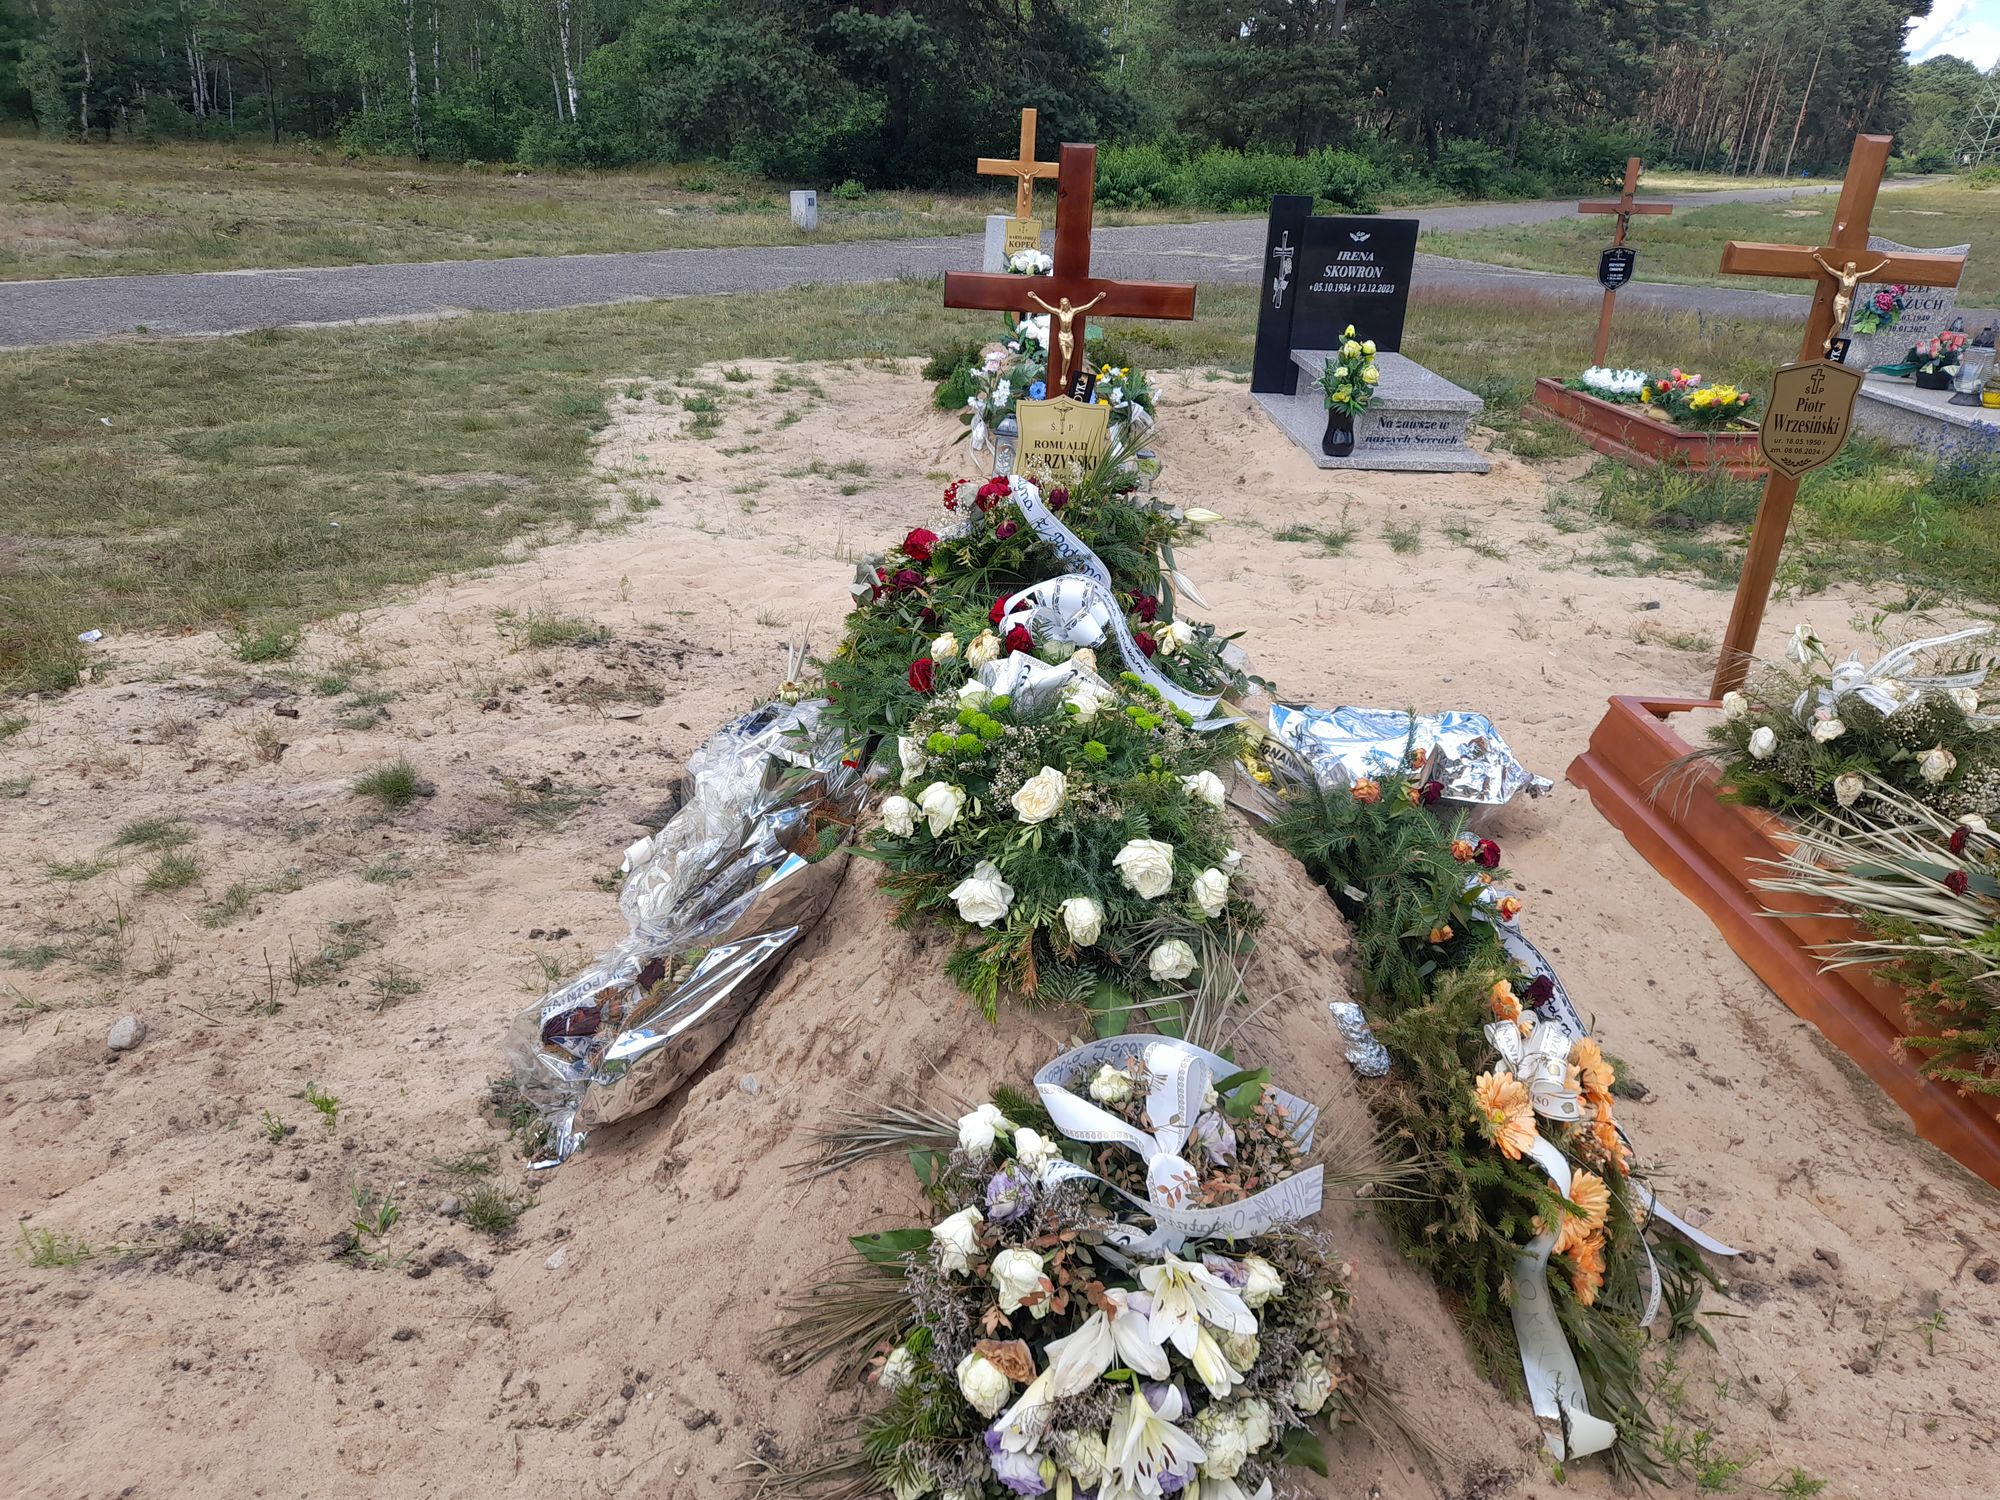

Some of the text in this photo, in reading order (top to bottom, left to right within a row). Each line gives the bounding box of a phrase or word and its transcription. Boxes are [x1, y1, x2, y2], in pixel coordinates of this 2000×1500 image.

[1337, 251, 1374, 261] IRENA
[1323, 265, 1384, 278] SKOWRON
[1357, 283, 1395, 293] 12.12.2023
[1796, 397, 1826, 412] Piotr
[1377, 417, 1450, 430] Na zawsze w
[1774, 413, 1840, 434] Wrzesiński
[1034, 440, 1088, 451] ROMUALD
